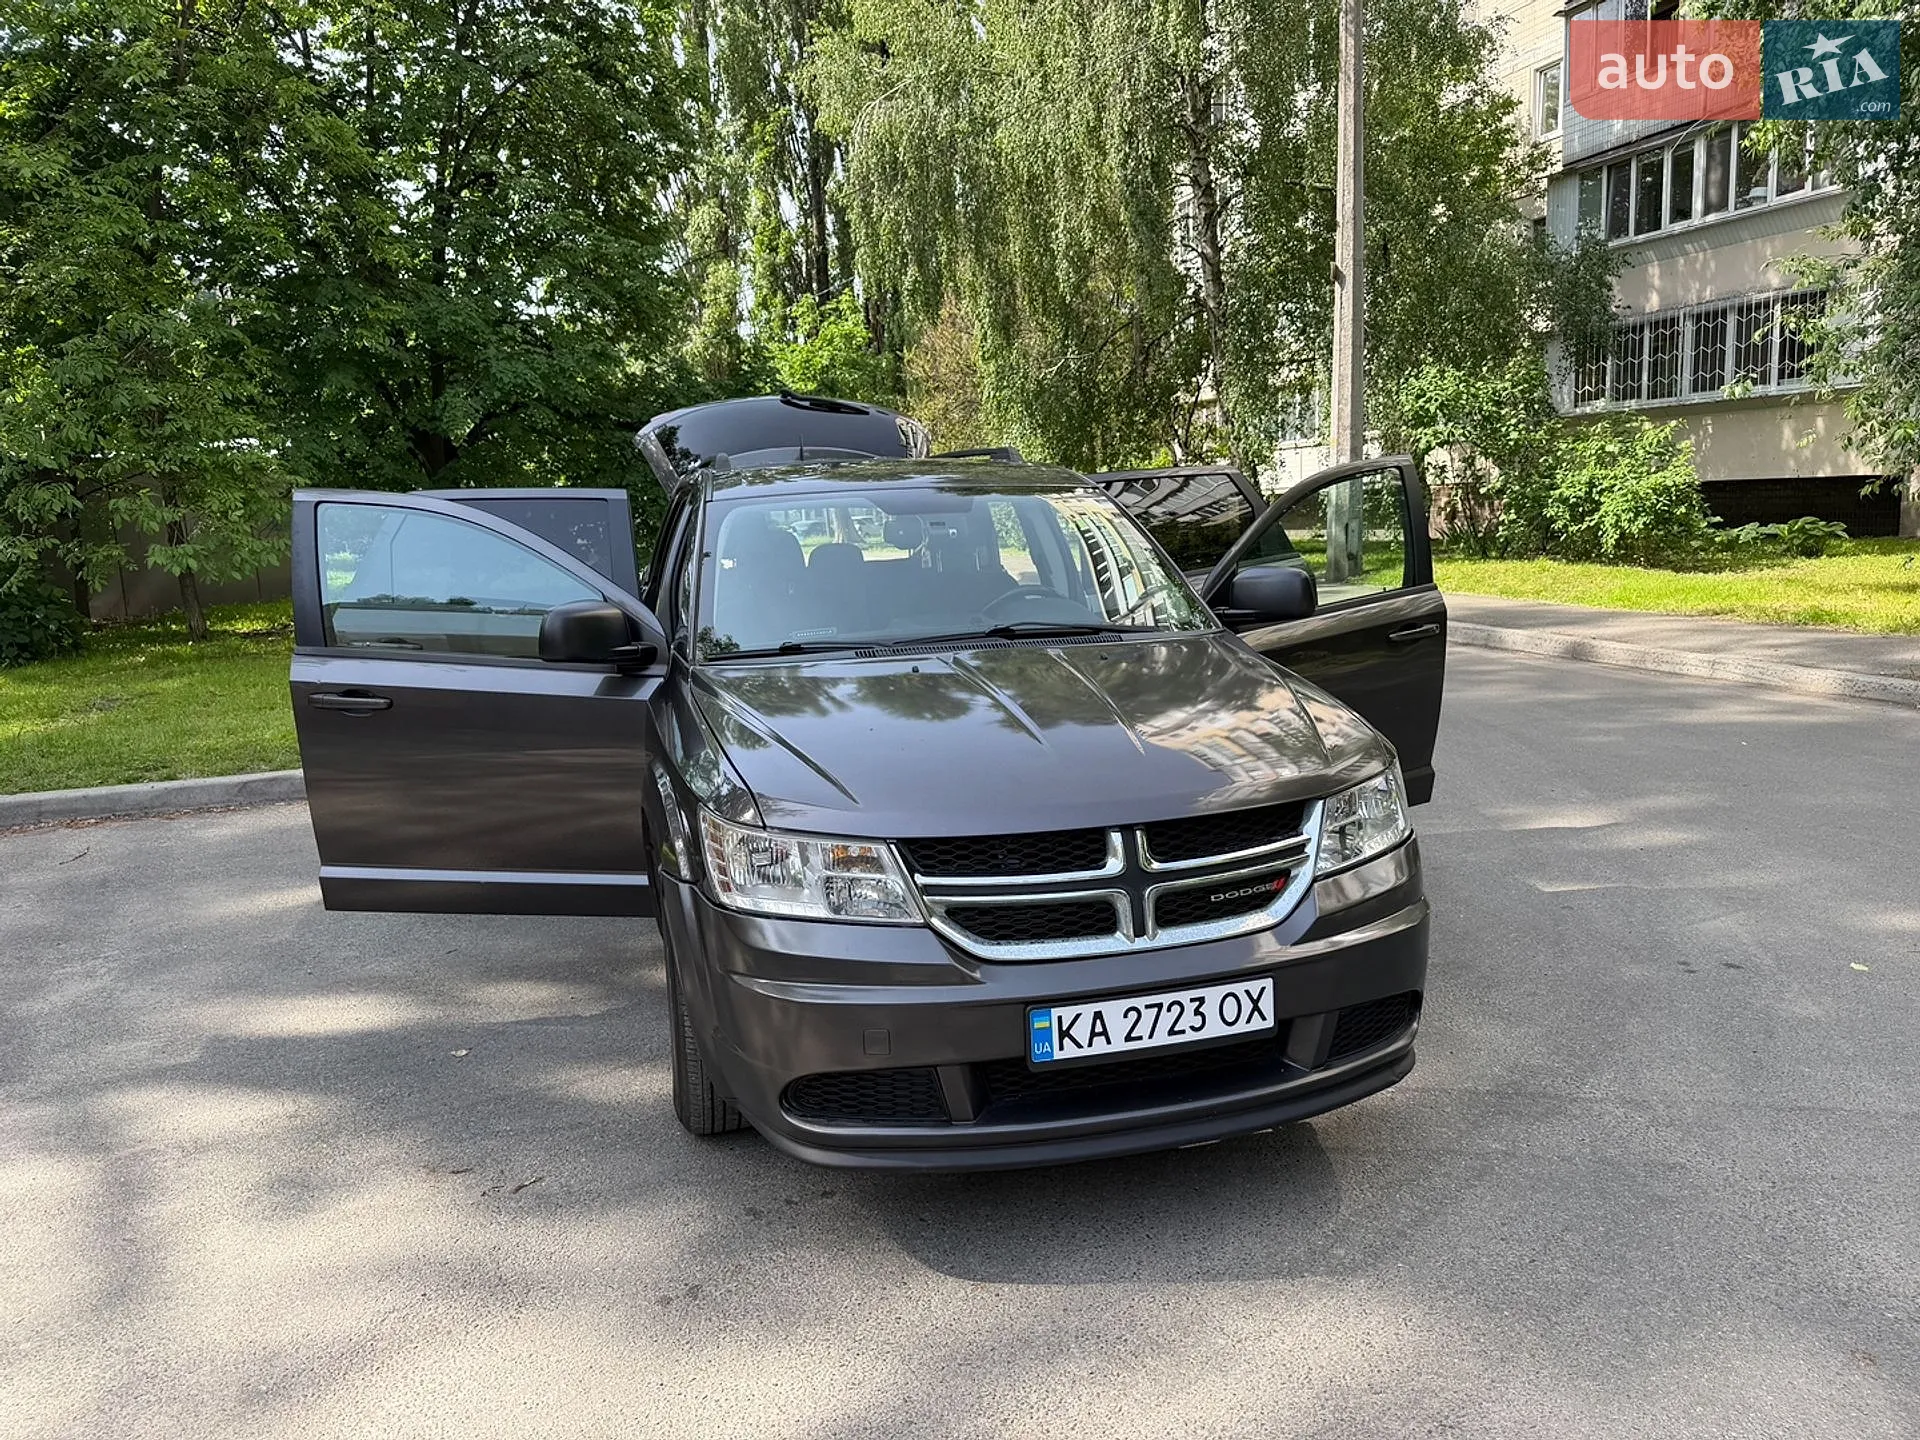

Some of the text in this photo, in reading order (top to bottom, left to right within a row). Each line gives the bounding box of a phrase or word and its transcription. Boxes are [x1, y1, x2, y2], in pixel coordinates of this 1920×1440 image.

[1210, 882, 1275, 902] DODGE
[1056, 986, 1268, 1052] KA 2723 OX
[1034, 1041, 1052, 1055] UA
